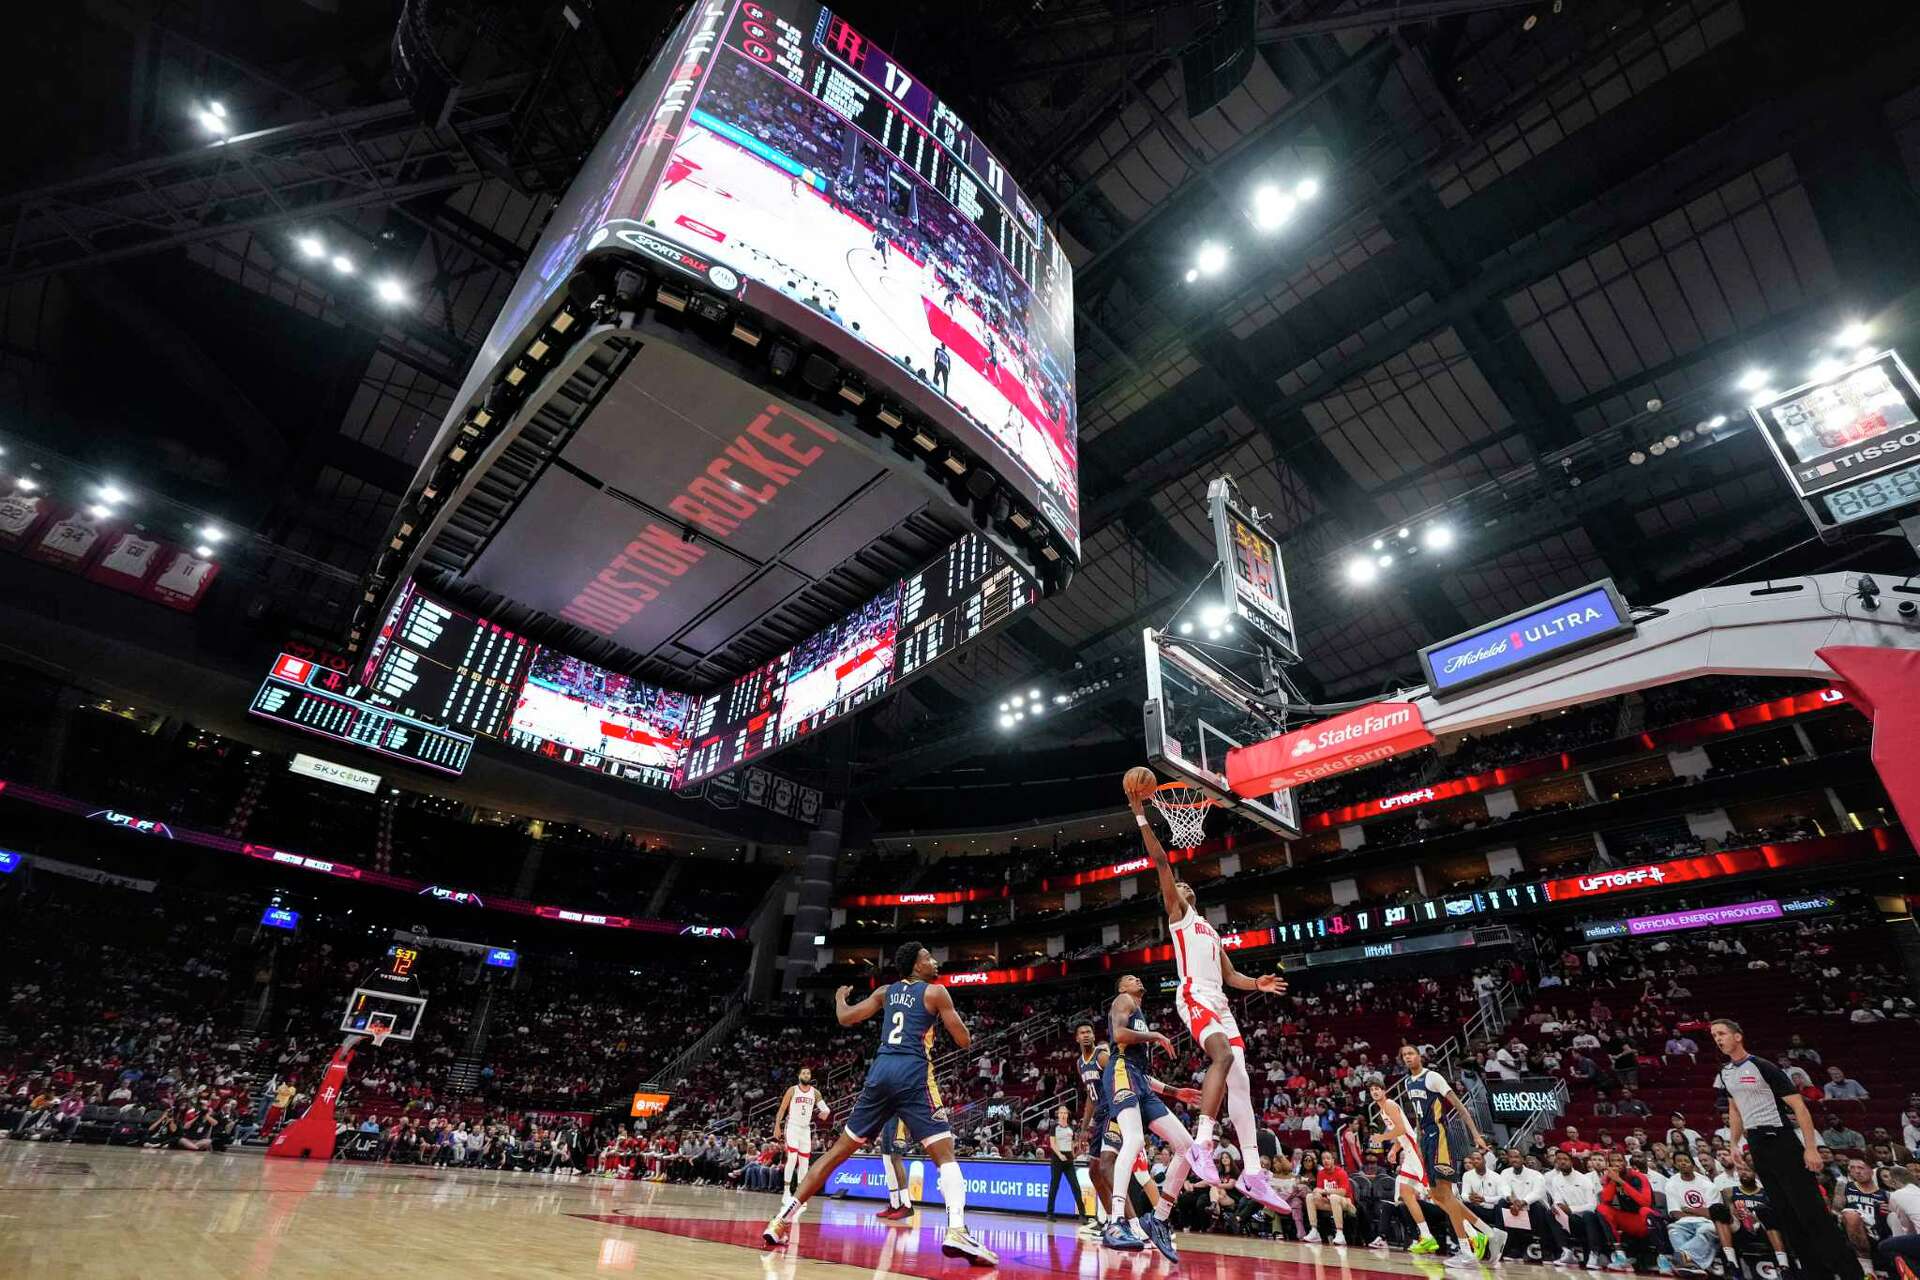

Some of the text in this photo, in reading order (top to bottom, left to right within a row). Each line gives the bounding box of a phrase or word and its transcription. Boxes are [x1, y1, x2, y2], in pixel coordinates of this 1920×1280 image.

[1835, 431, 1920, 468] TISSO
[1, 505, 22, 519] 22
[61, 528, 83, 543] 34
[560, 523, 706, 636] HOUSTON
[1443, 607, 1602, 673] Michelob ULTRA
[1379, 792, 1424, 809] LIFTOFF
[1579, 870, 1650, 892] LIFTOFF
[1424, 902, 1437, 919] 11
[1781, 898, 1821, 912] reliant
[1357, 912, 1368, 930] 17
[1632, 904, 1776, 931] OFFICIAL ENERGY PROVIDER
[1586, 925, 1617, 938] reliant
[395, 949, 417, 960] 5:37
[393, 958, 412, 975] 12
[890, 993, 915, 1008] JONES
[888, 1011, 904, 1044] 2
[936, 1178, 1048, 1198] SRIOR LIGHT BEE
